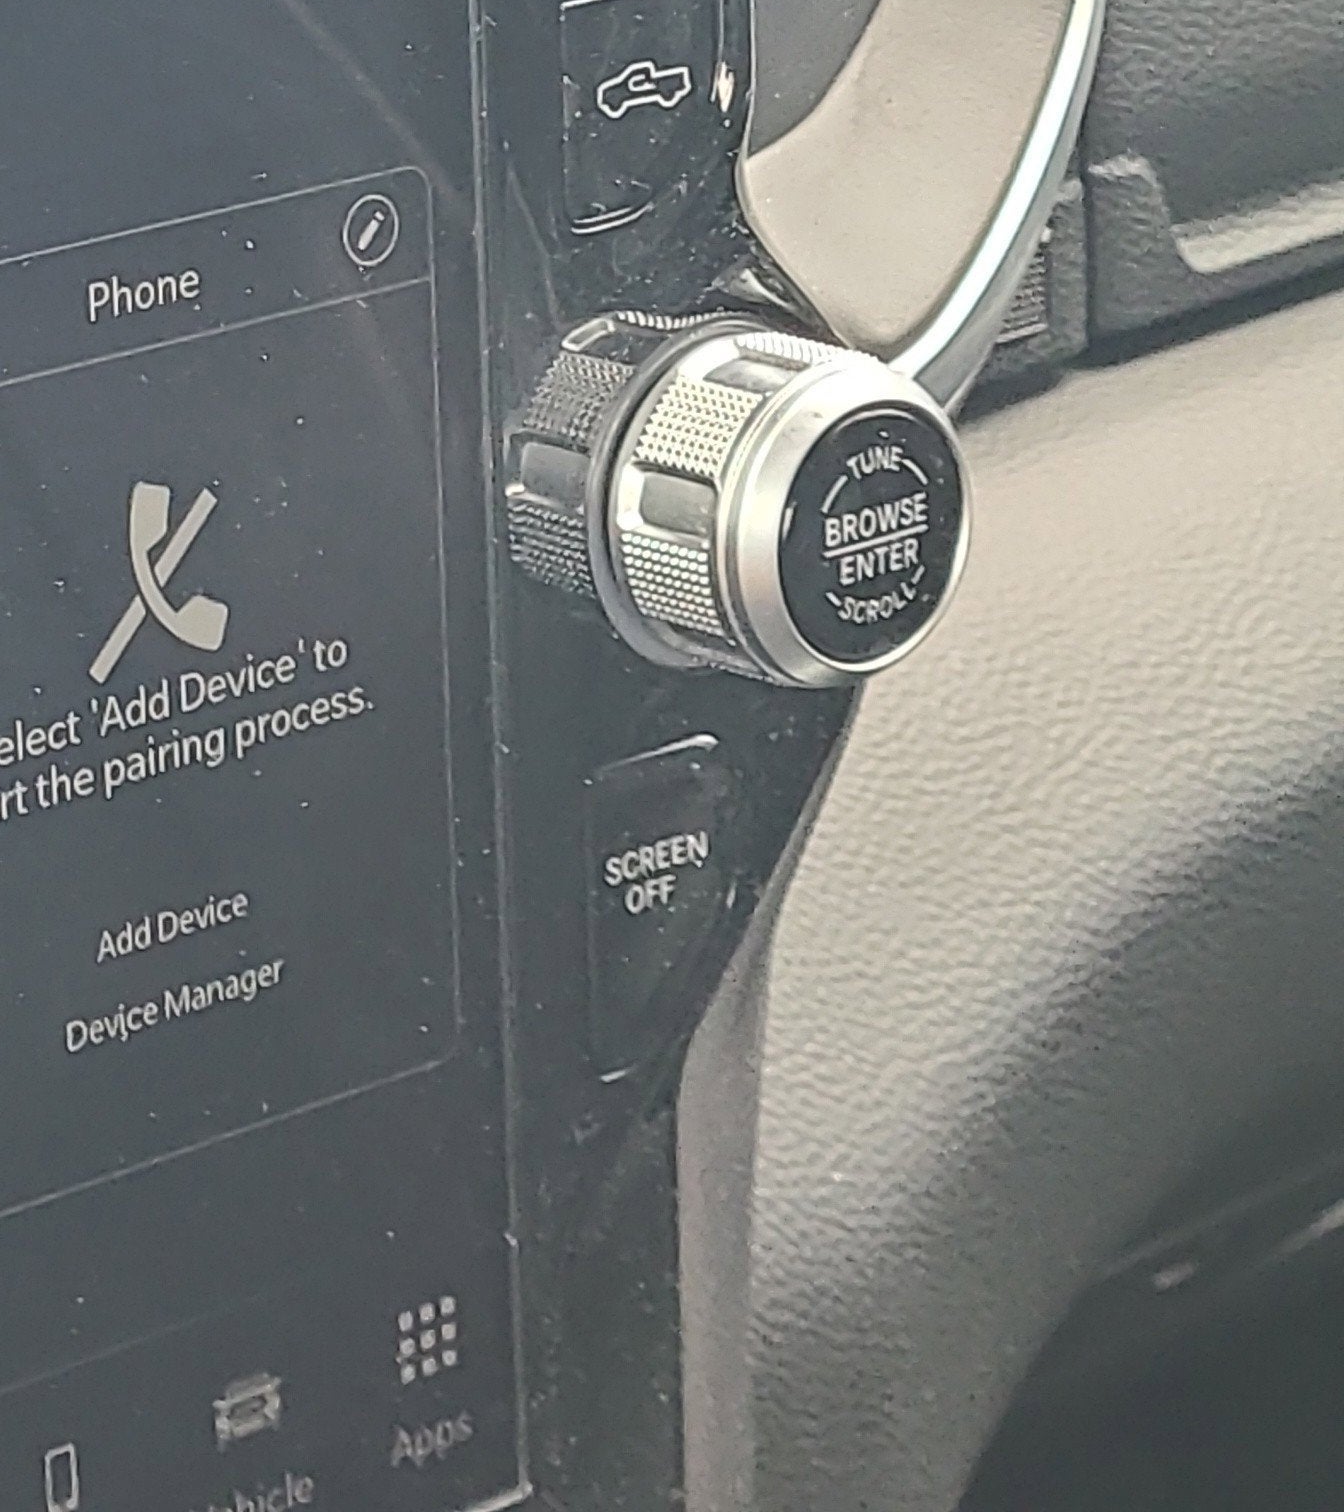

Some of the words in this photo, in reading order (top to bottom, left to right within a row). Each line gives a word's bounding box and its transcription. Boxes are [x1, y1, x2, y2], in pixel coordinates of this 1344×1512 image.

[86, 267, 203, 324] Phone
[846, 444, 904, 480] TUNE
[823, 492, 929, 549] BROWSE
[838, 538, 919, 587] ENTER
[836, 578, 918, 626] SCROLL
[89, 684, 172, 738] 'Add
[178, 637, 307, 715] Device'
[313, 637, 348, 672] to
[36, 756, 95, 807] the
[102, 722, 226, 800] pairing
[233, 684, 375, 760] process.
[603, 830, 711, 887] SCREEN
[624, 874, 676, 916] OFF
[95, 914, 154, 965] Add
[158, 891, 250, 944] Device
[65, 1005, 159, 1054] Device
[162, 955, 285, 1022] Manager
[389, 1409, 474, 1468] Apps
